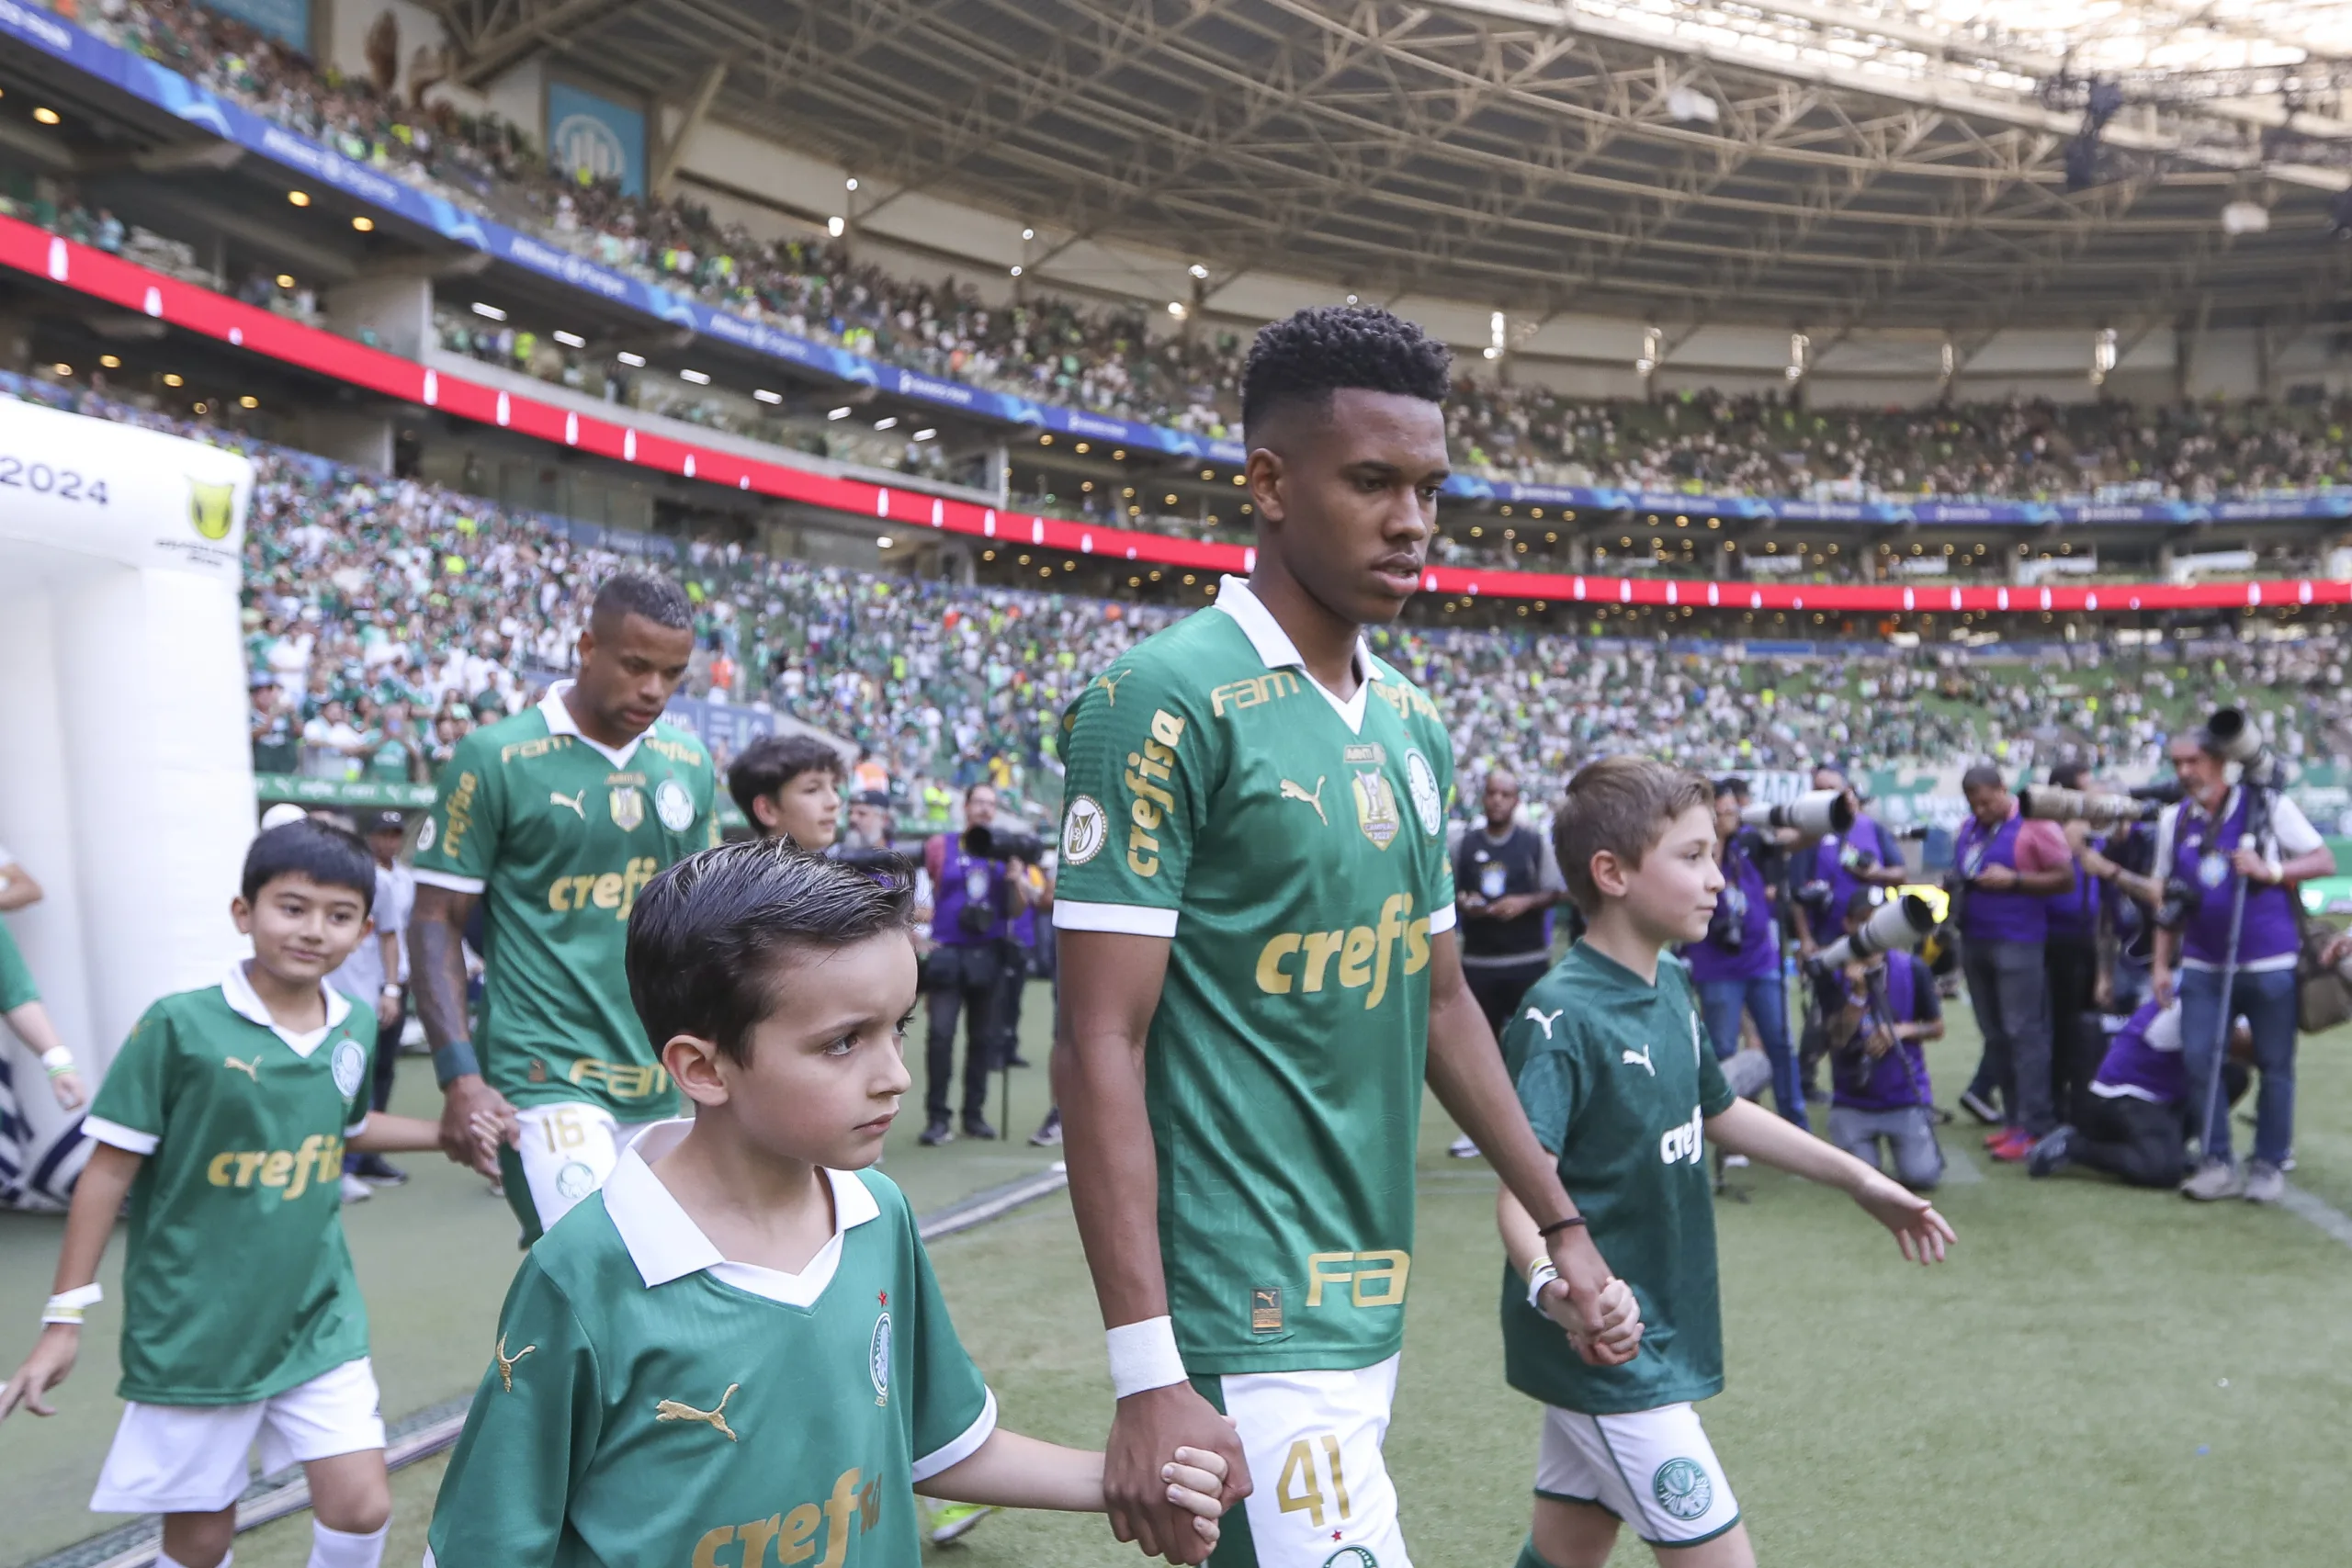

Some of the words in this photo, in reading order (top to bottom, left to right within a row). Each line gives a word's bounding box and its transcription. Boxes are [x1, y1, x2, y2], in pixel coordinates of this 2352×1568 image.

[0, 457, 108, 506] 2024
[1125, 708, 1187, 878] crefisa
[542, 1108, 586, 1155] 16
[1275, 1434, 1351, 1528] 41
